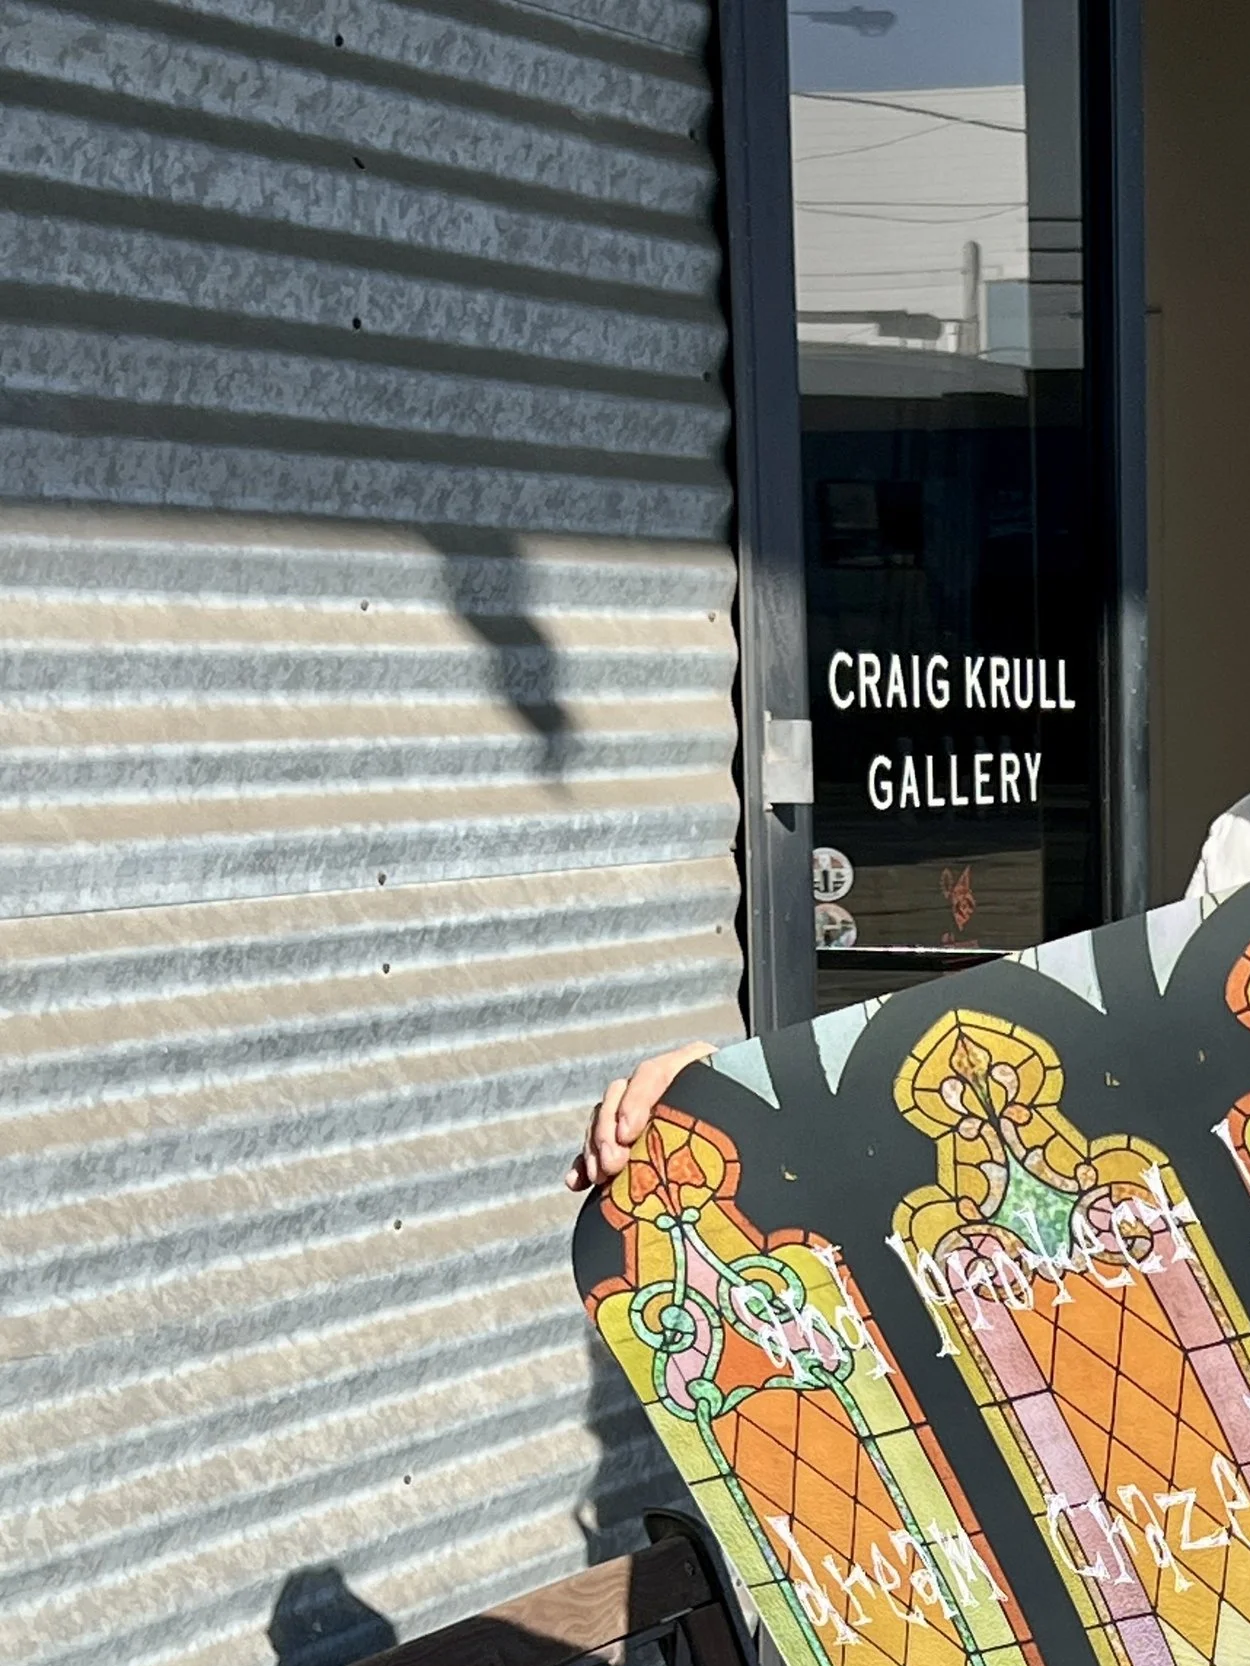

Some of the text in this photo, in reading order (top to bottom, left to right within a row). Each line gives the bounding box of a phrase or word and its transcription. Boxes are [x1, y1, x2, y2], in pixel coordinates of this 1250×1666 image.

[828, 651, 1076, 709] CRAIG KRULL
[868, 753, 1042, 810] GALLERY
[885, 1162, 1200, 1357] protect
